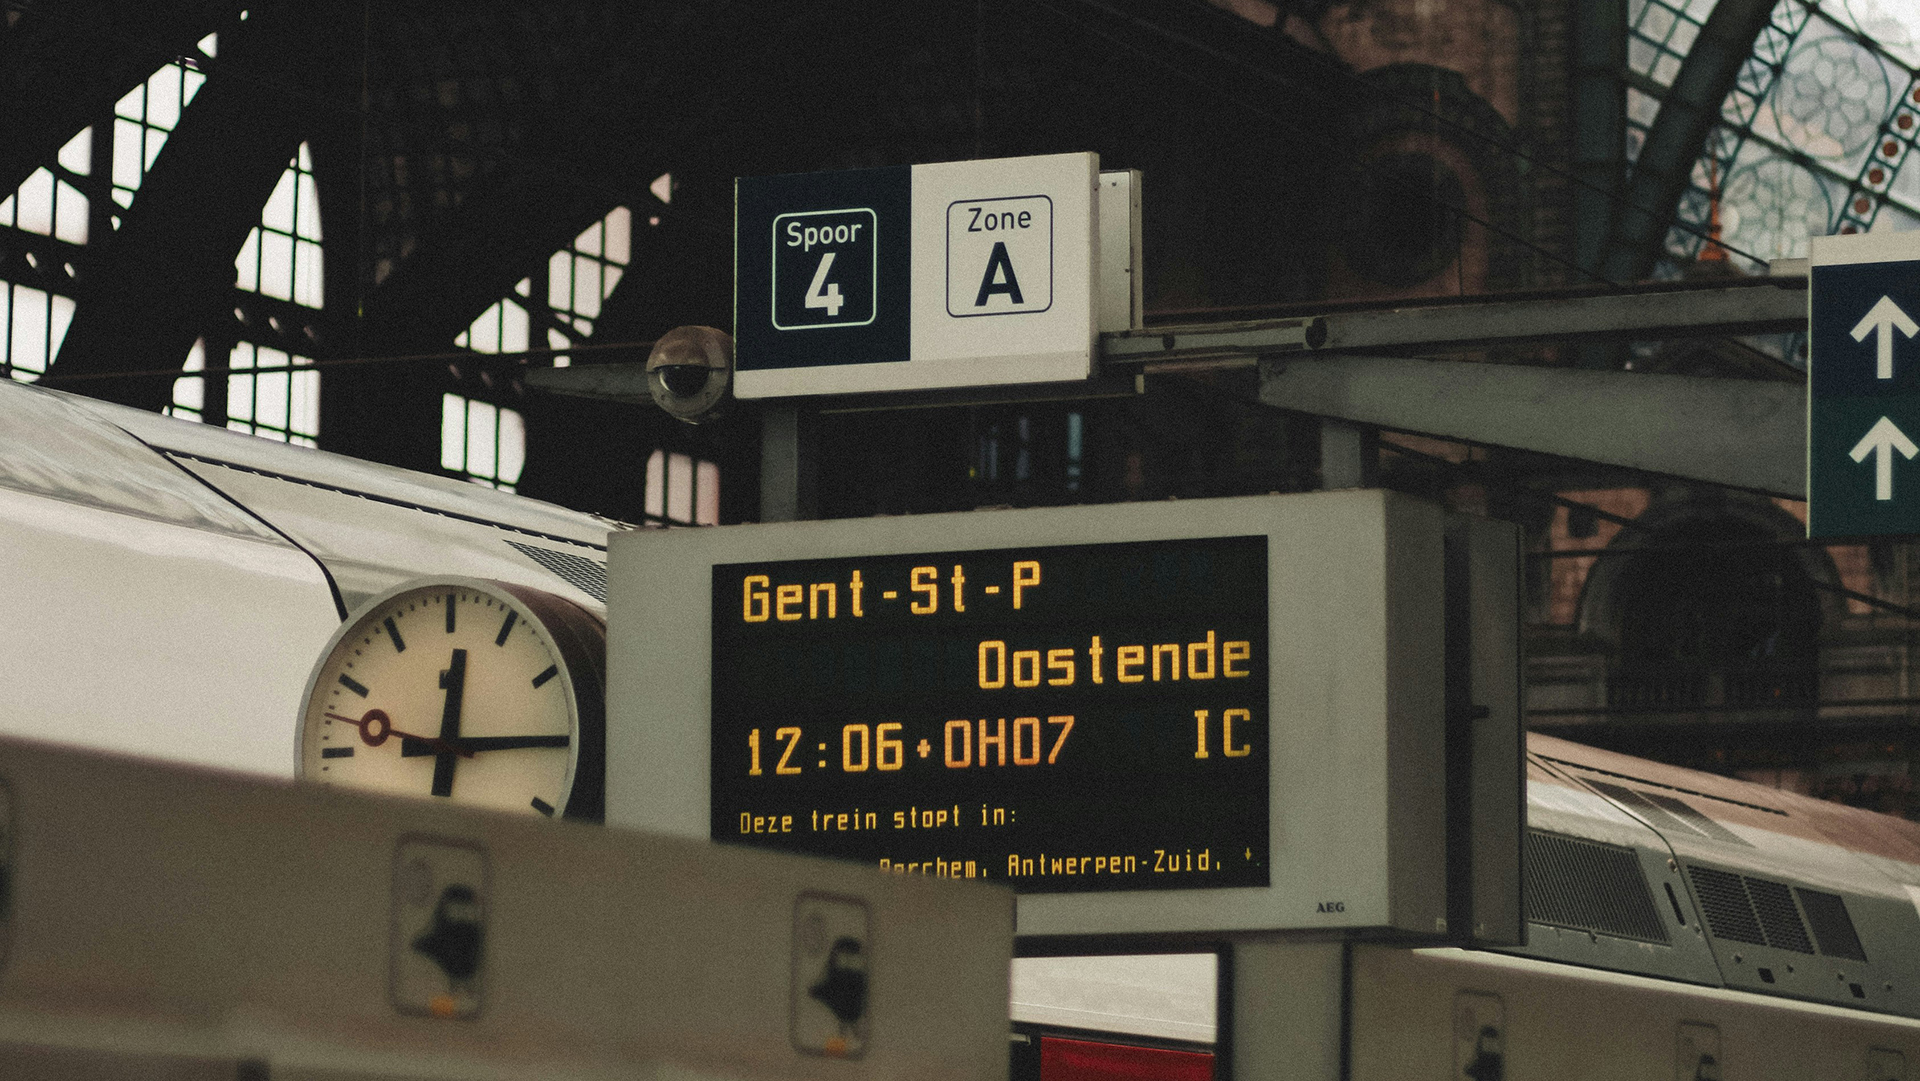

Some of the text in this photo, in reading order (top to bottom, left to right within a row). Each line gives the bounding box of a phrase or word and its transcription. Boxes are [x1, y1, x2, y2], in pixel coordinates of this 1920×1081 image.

[967, 207, 1032, 232] Zone
[786, 221, 862, 252] Spoor
[804, 252, 844, 316] 4
[974, 241, 1025, 307] A
[978, 630, 1251, 690] Oostende
[1193, 708, 1251, 760] IC
[740, 803, 1016, 834] Deze trein stopt in:
[1007, 848, 1221, 877] Antwerpen-Zuid,
[1316, 901, 1345, 914] AEG
